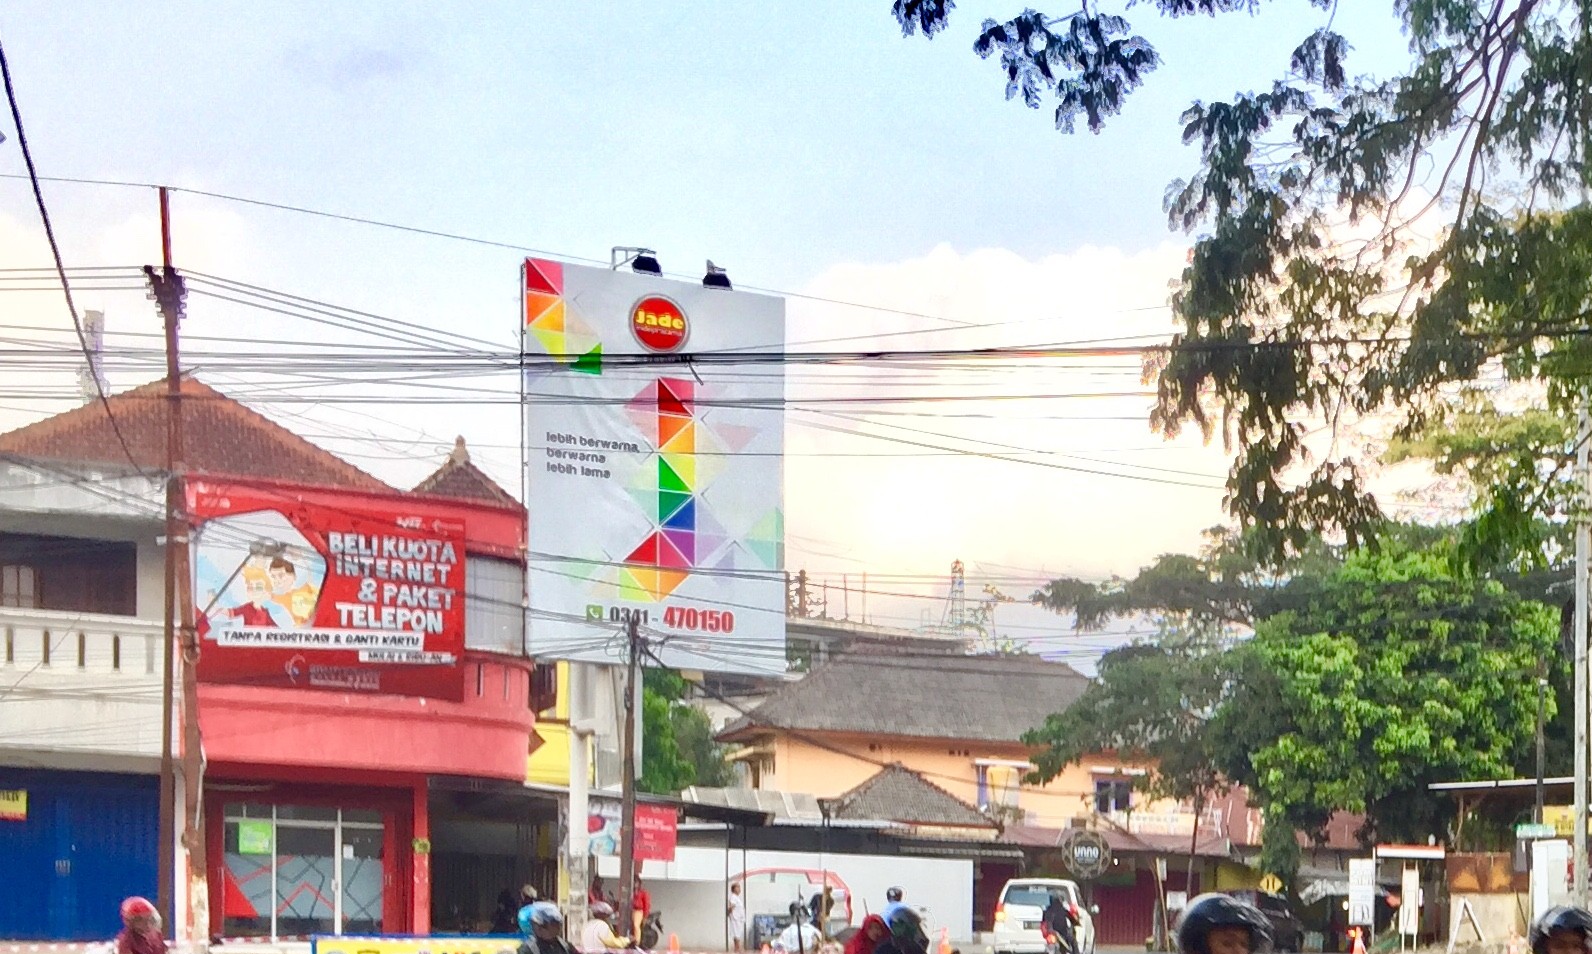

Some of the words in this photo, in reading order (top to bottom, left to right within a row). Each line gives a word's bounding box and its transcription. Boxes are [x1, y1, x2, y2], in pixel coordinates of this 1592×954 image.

[635, 309, 684, 330] Jade
[546, 431, 577, 445] lebih
[546, 447, 606, 463] berwarna
[546, 462, 577, 475] lebih
[580, 466, 611, 479] lama
[328, 530, 378, 557] BELI
[382, 534, 457, 565] KUOTA
[336, 554, 451, 585] INTERNET
[358, 577, 377, 603] &
[383, 582, 456, 610] PAKET
[335, 604, 444, 634] TELEPON
[610, 606, 649, 626] 0341
[662, 605, 735, 634] 470150
[223, 630, 262, 642] TANPA
[265, 631, 329, 643] REGISTRASI
[345, 634, 378, 645] GANTI
[382, 635, 420, 647] KARTU
